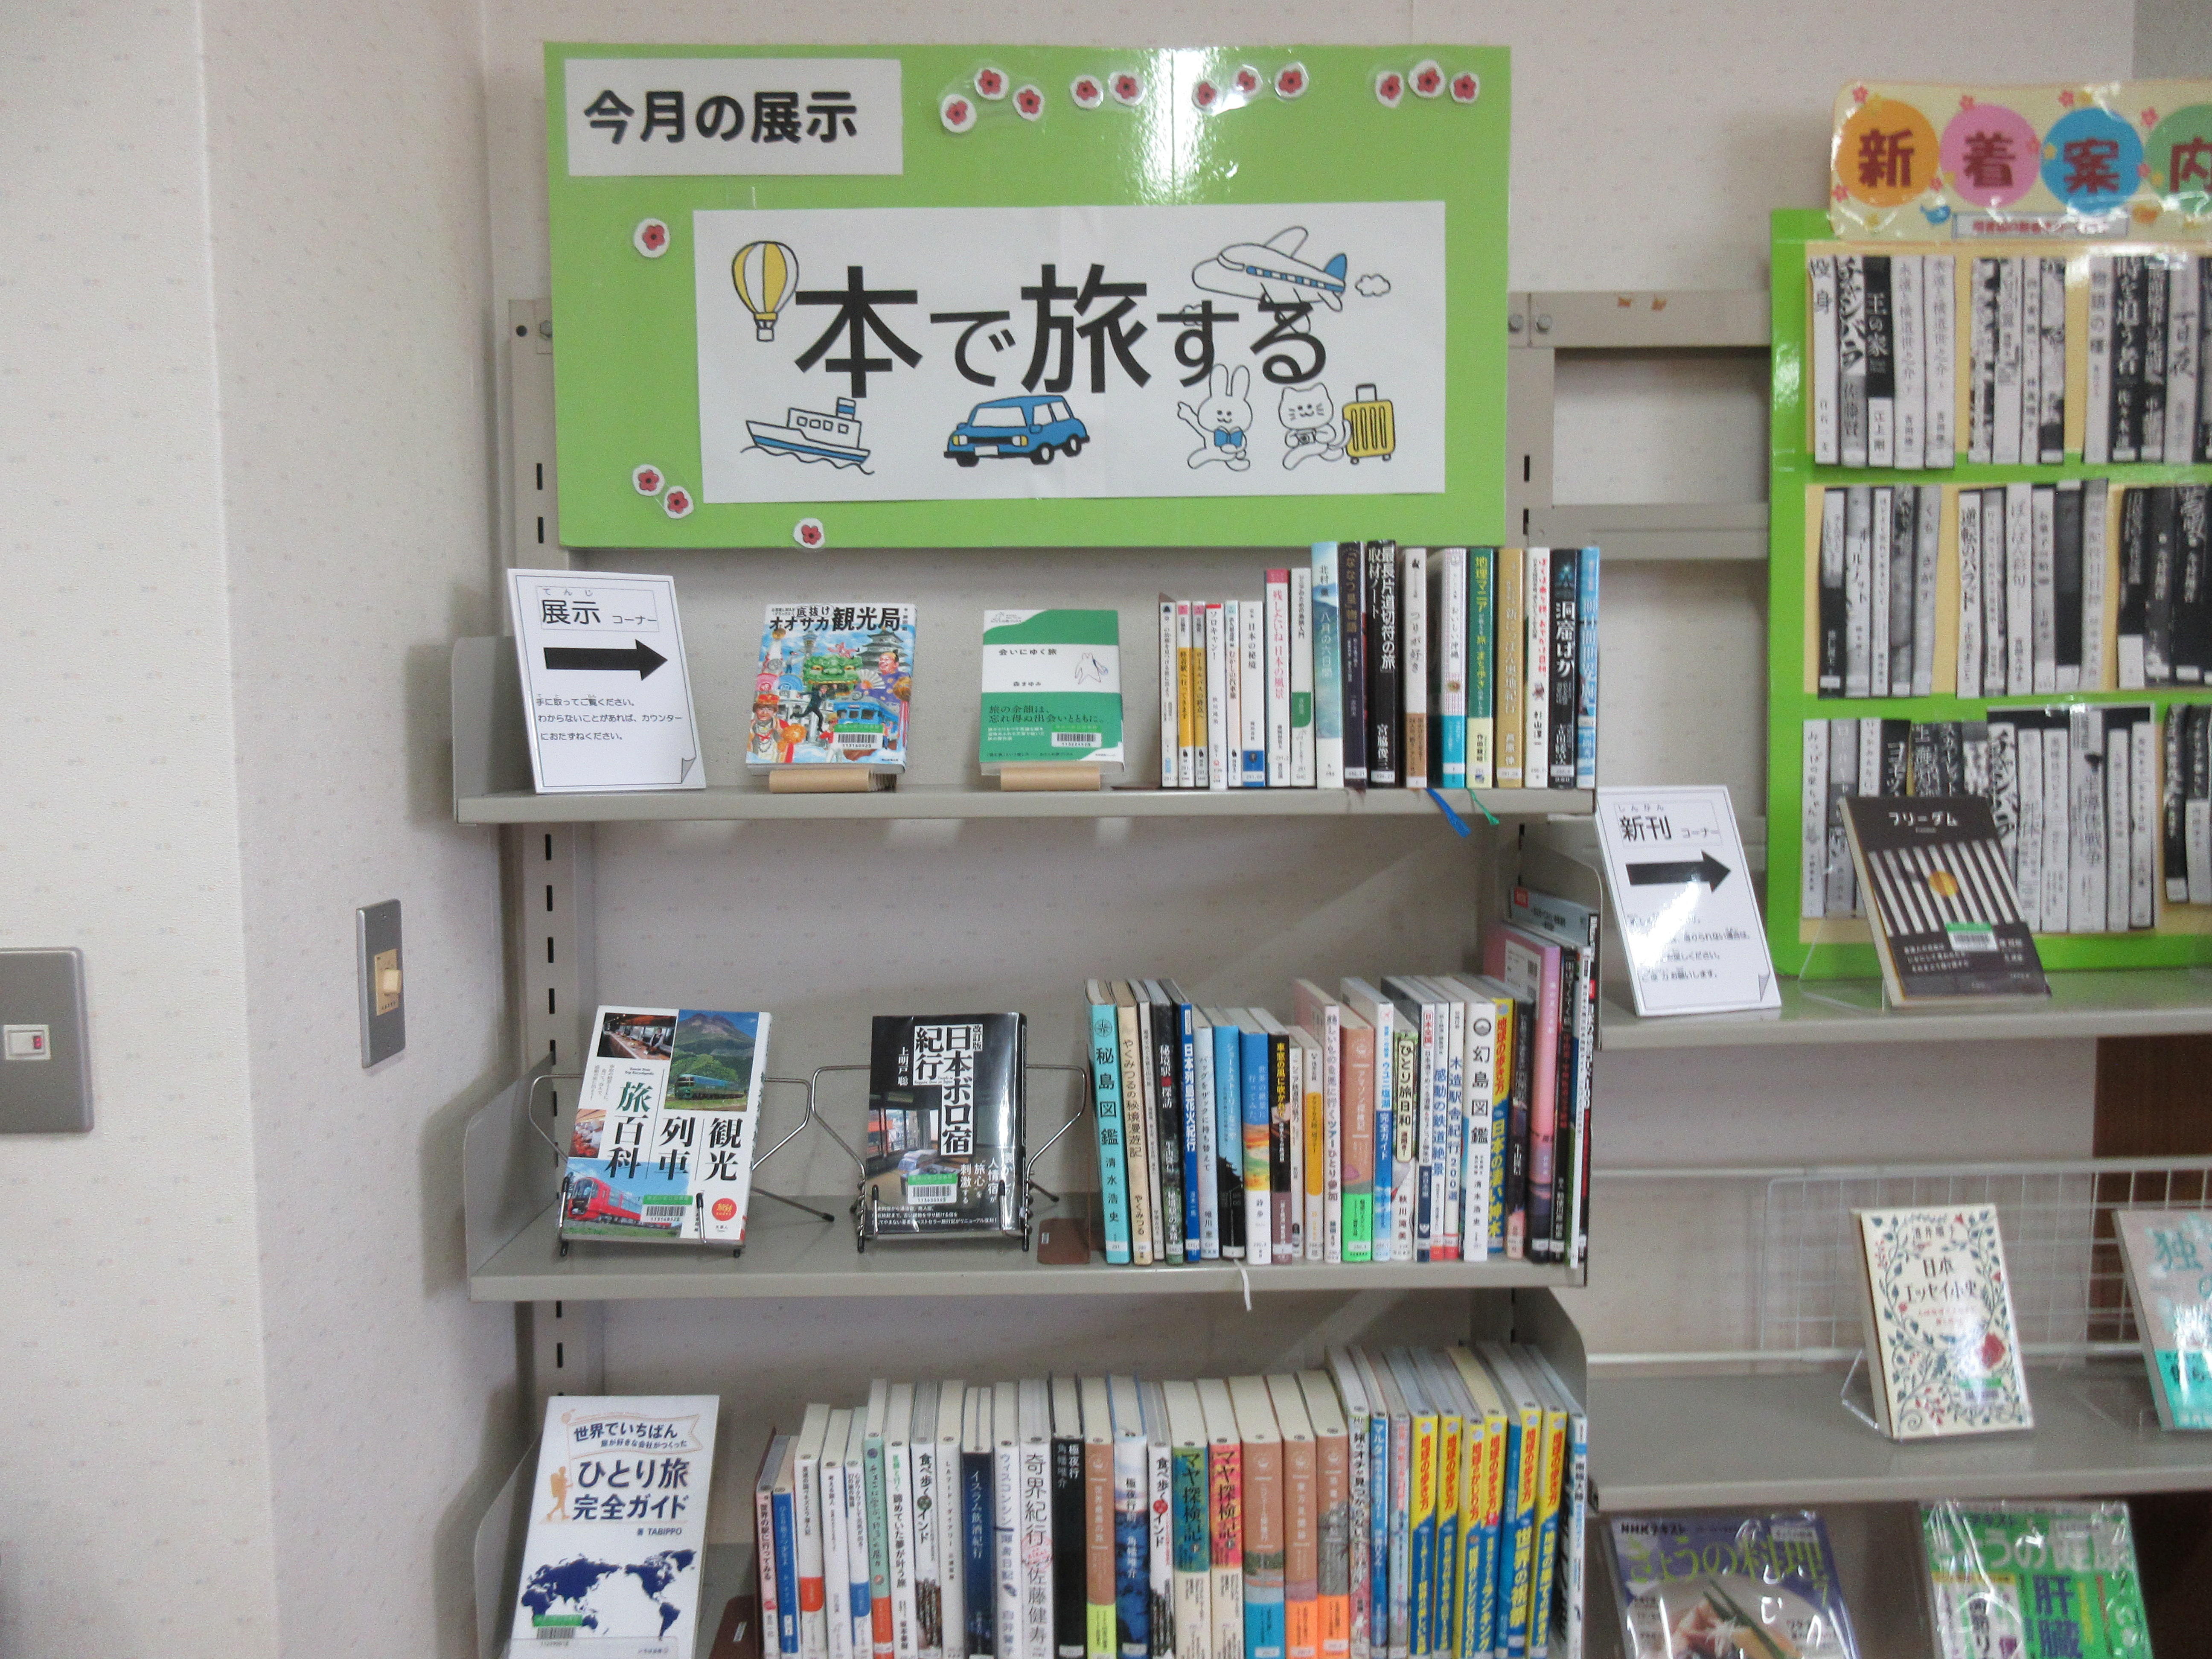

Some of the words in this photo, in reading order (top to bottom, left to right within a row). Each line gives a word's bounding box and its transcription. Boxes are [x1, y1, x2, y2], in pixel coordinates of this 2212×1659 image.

[584, 88, 858, 145] 今月の展示
[1858, 128, 2212, 194] 新着案内
[794, 264, 1328, 398] 本で旅する
[1368, 547, 1382, 619] 取材ノート
[542, 600, 601, 625] 展示
[612, 615, 658, 625] コーナー
[769, 616, 830, 632] オオサカ
[832, 606, 900, 632] 観光局
[797, 606, 830, 617] 底抜け
[1248, 623, 1257, 670] 日本の秘境
[1321, 612, 1333, 679] 八月の六日間
[1556, 601, 1576, 678] 洞窟ばか
[536, 698, 634, 707] 手に取ってご覧ください。
[538, 714, 682, 723] わからないことがあれば、カウンター
[989, 705, 1049, 713] 旅の余韻は、
[989, 714, 1103, 723] 忘れ得ぬ出会いとともに。
[541, 732, 623, 741] におたずねください。
[1620, 815, 1672, 842] 新刊
[1681, 827, 1720, 838] コーナー
[1889, 812, 1958, 827] フリーダム
[915, 1026, 943, 1081] 紀行
[972, 1025, 982, 1051] 改訂版
[1424, 1012, 1433, 1048] 日本全国
[1493, 1016, 1507, 1096] 地球の歩き方
[942, 1025, 973, 1154] 日本ボロ宿
[1095, 1047, 1119, 1147] 秘島図鑑
[1122, 1039, 1143, 1159] やくみつるの秘境漫遊記
[1183, 1042, 1196, 1153] 日本列島花火紀行
[1399, 1045, 1413, 1126] ひとり旅日和
[1470, 1045, 1491, 1144] 幻島図鑑
[605, 1082, 653, 1179] 旅百科
[1199, 1055, 1211, 1173] バッグをザックに持ち替えて
[1379, 1112, 1389, 1160] 完全ガイド
[1432, 1068, 1447, 1176] 感動の鉄道絶景
[1447, 1057, 1462, 1201] 木造駅舎紀行200選
[655, 1116, 696, 1181] 列車
[704, 1117, 744, 1181] 観光
[960, 1164, 972, 1205] 刺激する
[987, 1157, 999, 1203] 人情宿が
[1105, 1157, 1118, 1222] 清水浩史
[1134, 1195, 1146, 1235] やくみつる
[1905, 1281, 1976, 1301] エッセイ小史
[1921, 1259, 1954, 1278] 日本
[574, 1422, 678, 1442] 世界でいちばん
[600, 1439, 688, 1448] 旅が好きな会社がつくった
[578, 1458, 690, 1490] ひとり旅
[1069, 1444, 1080, 1479] 極夜行
[572, 1493, 690, 1521] 完全ガイド
[970, 1470, 983, 1559] イスラム飲酒紀行
[1025, 1453, 1047, 1546] 奇界紀行
[1182, 1452, 1202, 1541] マヤ探検記
[1217, 1450, 1237, 1539] マヤ探検記
[648, 1527, 682, 1535] TABIPPO
[1028, 1564, 1046, 1643] 佐藤健寿
